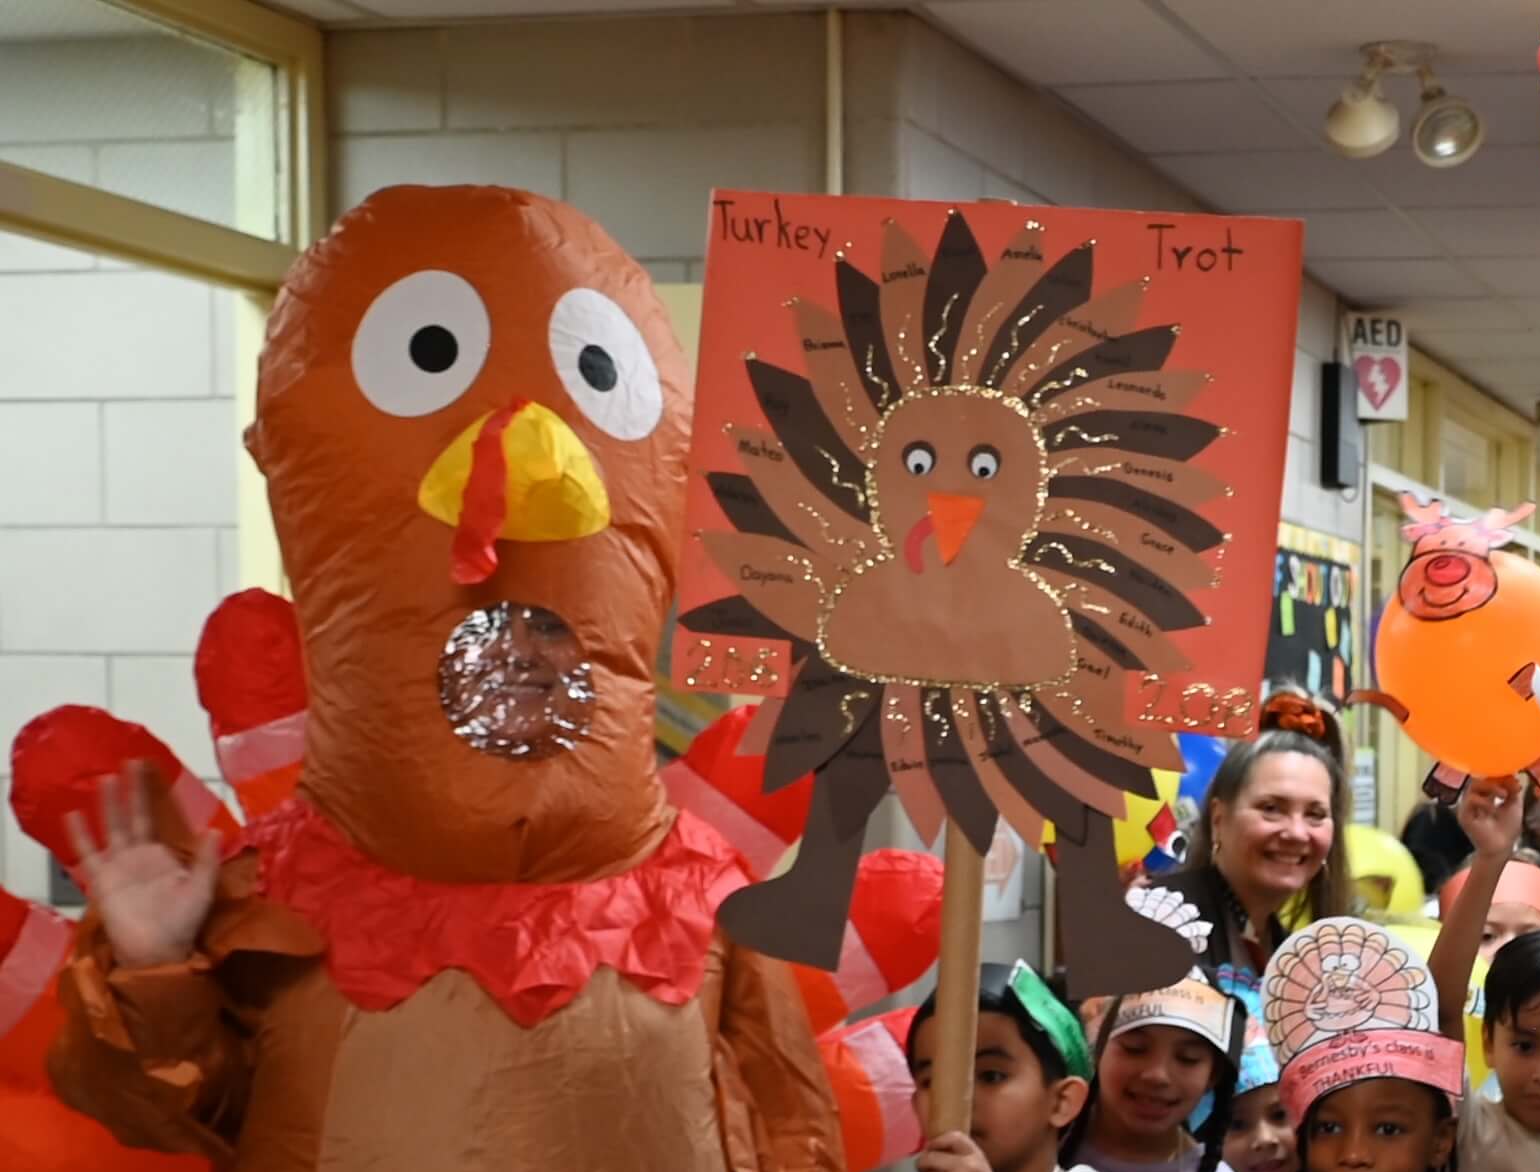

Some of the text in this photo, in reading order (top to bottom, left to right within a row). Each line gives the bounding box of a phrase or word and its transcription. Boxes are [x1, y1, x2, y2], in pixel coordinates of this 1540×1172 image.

[714, 198, 1244, 272] Turkey Trot
[1352, 317, 1403, 347] AED
[1121, 461, 1174, 483] Genesis
[1385, 1039, 1421, 1057] class
